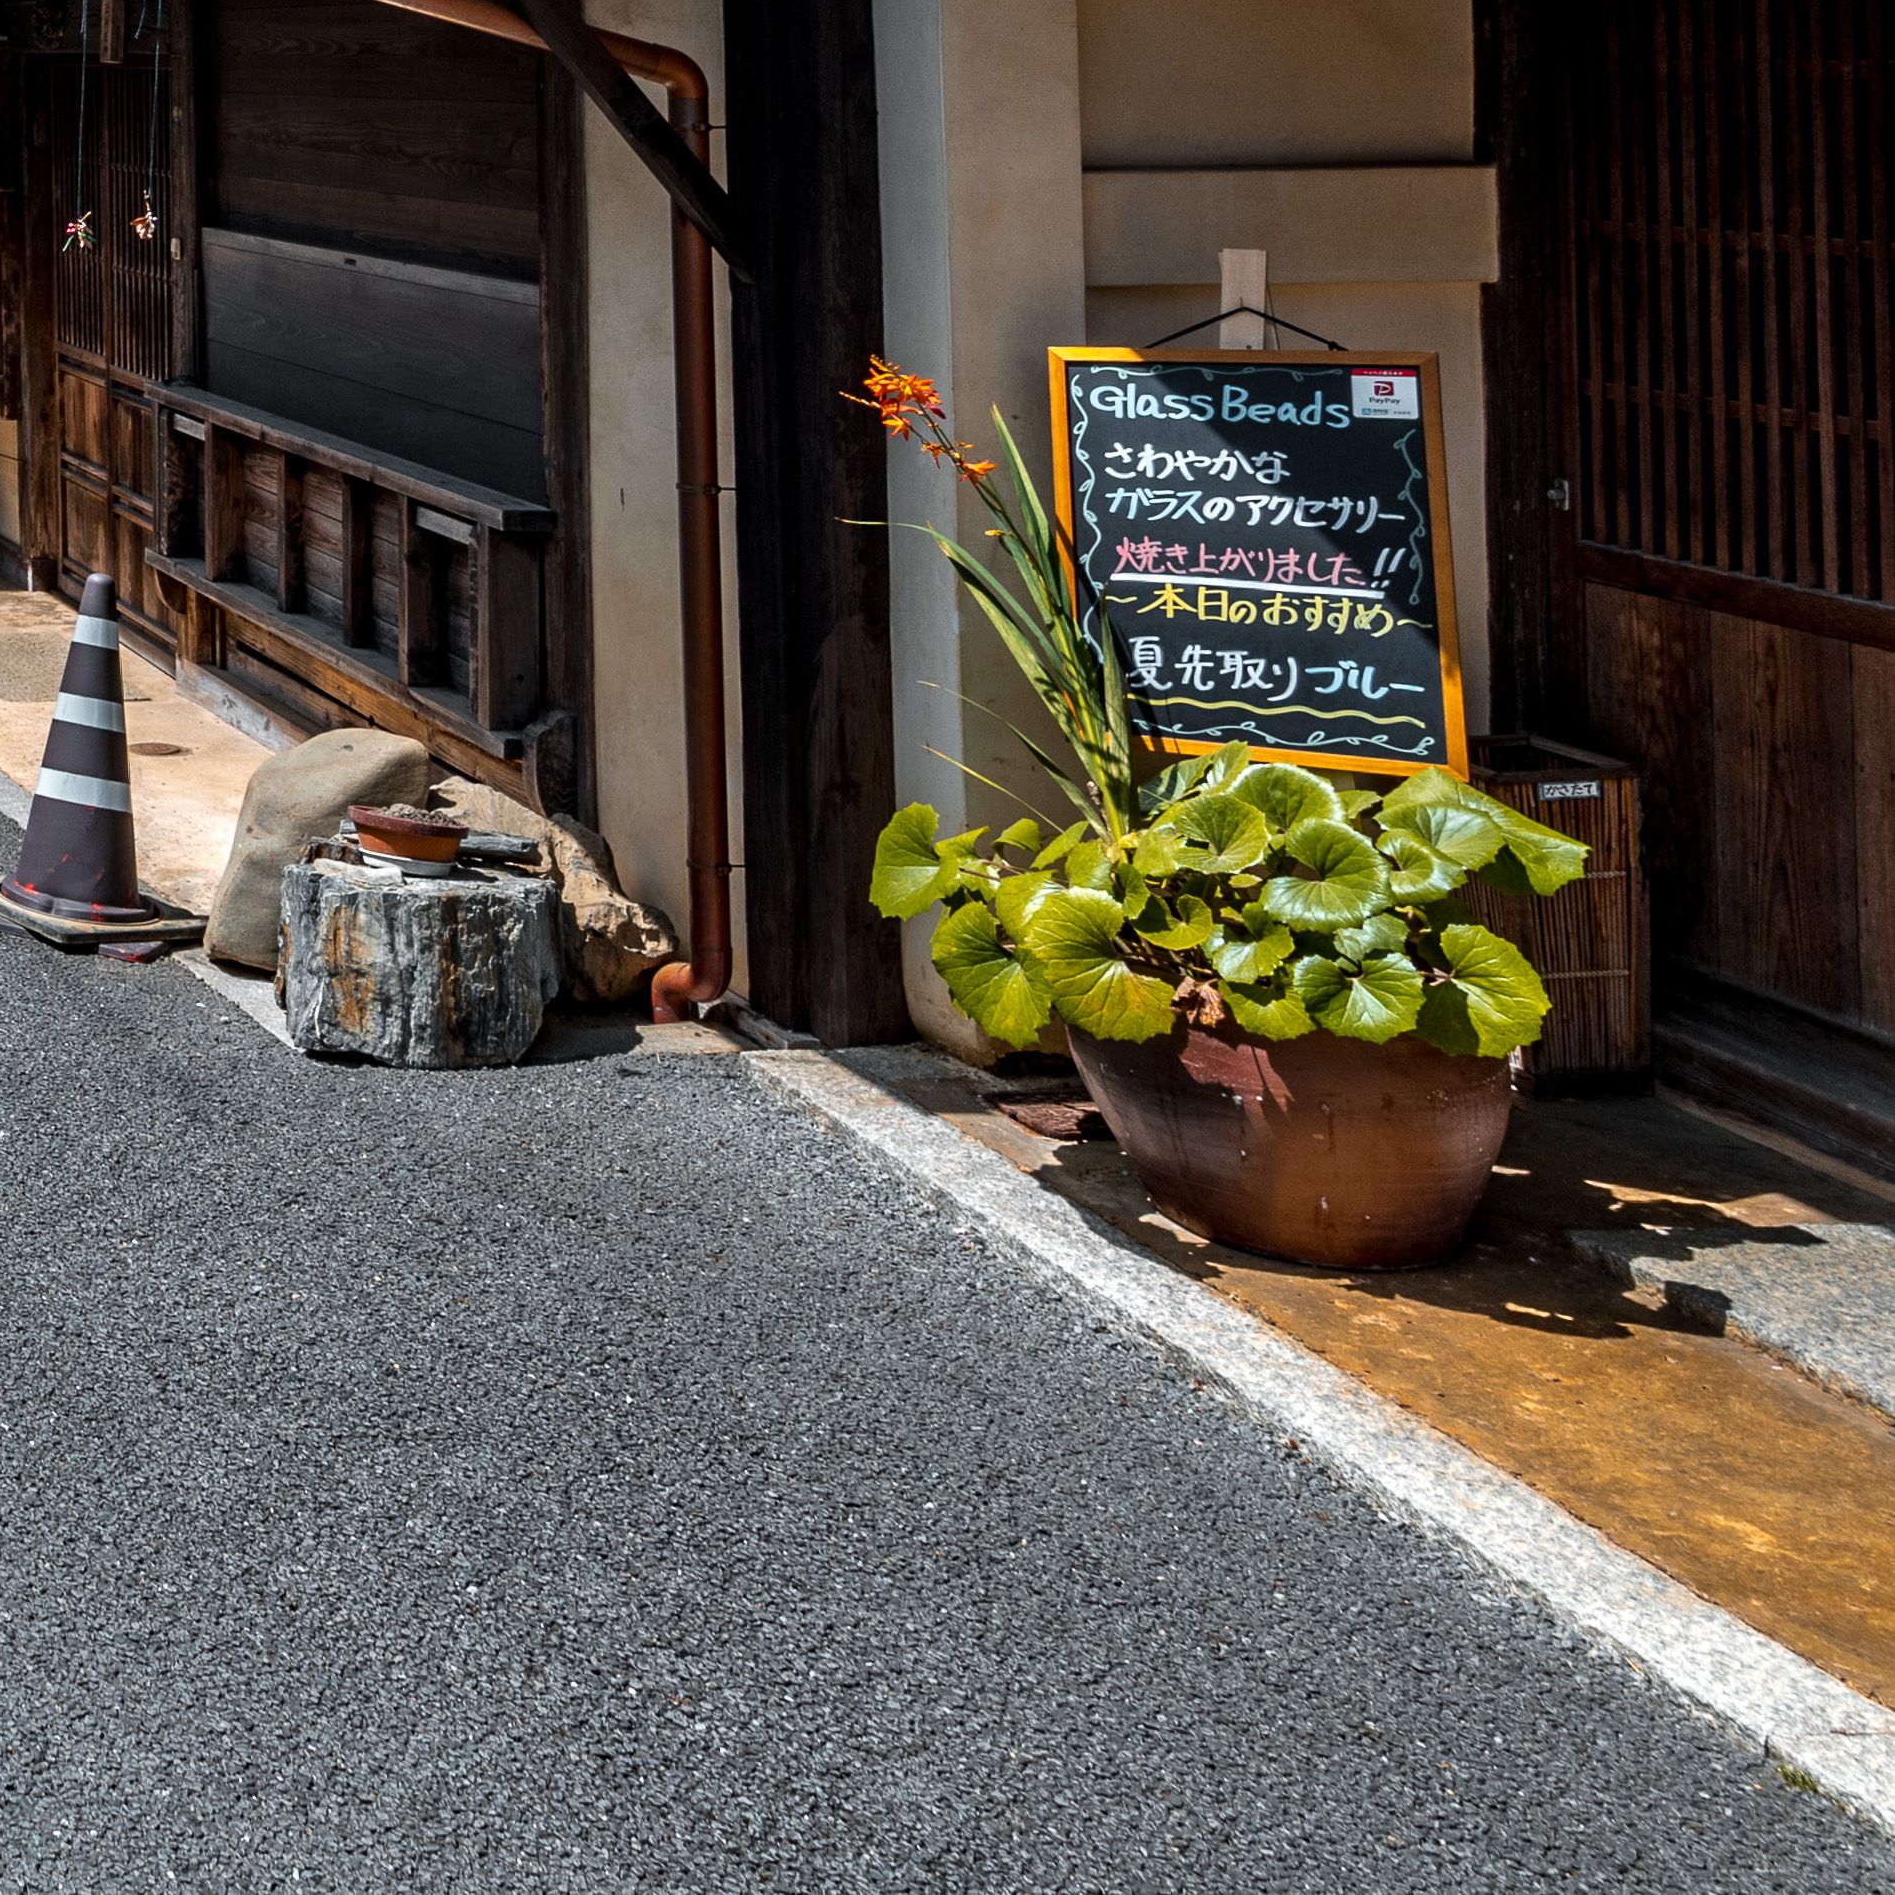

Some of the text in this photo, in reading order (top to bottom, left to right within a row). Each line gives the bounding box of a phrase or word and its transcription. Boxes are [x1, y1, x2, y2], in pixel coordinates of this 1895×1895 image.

[1090, 383, 1351, 428] Glass Beads
[1104, 442, 1291, 484] さわやかな
[1105, 487, 1406, 534] ガラスのアクセサリー
[1543, 783, 1593, 796] かさたて
